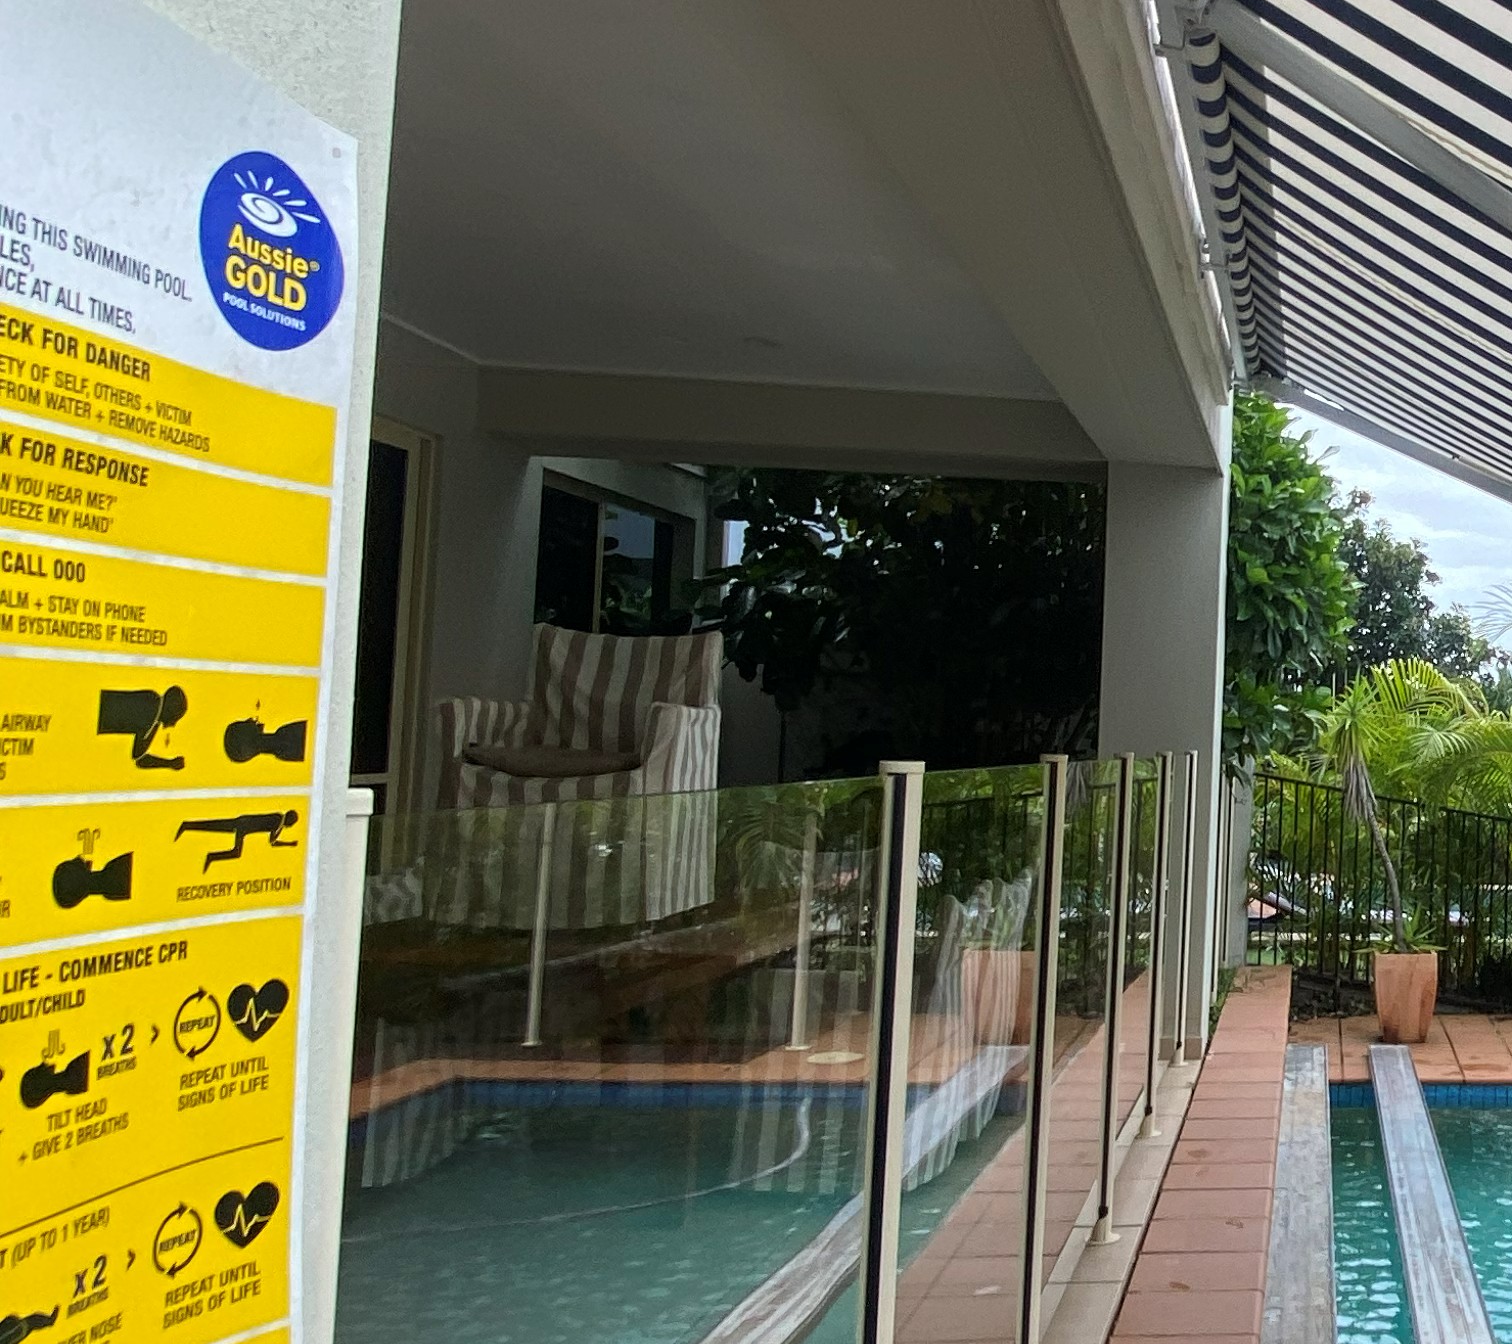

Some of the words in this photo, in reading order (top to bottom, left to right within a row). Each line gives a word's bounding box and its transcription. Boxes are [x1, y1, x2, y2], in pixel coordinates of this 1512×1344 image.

[33, 217, 67, 251] THIS
[73, 235, 150, 285] SWIMMING
[155, 269, 192, 302] POOL.
[31, 278, 52, 303] AT
[55, 287, 84, 315] ALL
[225, 255, 307, 312] GOLD
[223, 291, 248, 312] POOL
[249, 302, 306, 332] SOLUTIONS
[42, 327, 78, 359] FOR
[86, 342, 150, 382] DANGER
[31, 363, 50, 384] OF
[55, 370, 89, 399] SELF,
[94, 382, 142, 411] OTHERS
[155, 400, 192, 427] VICTIM
[44, 390, 92, 419] WATER
[108, 409, 157, 438] REMOVE
[158, 424, 211, 453] HAZARDS
[19, 437, 56, 467] FOR
[61, 447, 150, 487] RESPONSE
[15, 475, 44, 498] YOU
[46, 481, 82, 506] HEAR
[47, 504, 70, 527] MY
[1, 550, 47, 578] CALL
[48, 595, 80, 615] STAY
[83, 599, 101, 618] ON
[104, 602, 147, 623] PHONE
[18, 615, 103, 641] BYSTANDERS
[105, 624, 118, 641] IF
[121, 626, 168, 647] NEEDED
[176, 881, 234, 903] RECOVERY
[236, 876, 291, 896] POSITION
[3, 965, 40, 994] LIFE
[59, 946, 153, 983] COMMENCE
[158, 940, 188, 964] CPR
[119, 1022, 135, 1055] 2
[180, 1015, 215, 1034] REPEAT
[180, 1064, 227, 1091] REPEAT
[231, 1056, 269, 1078] UNTIL
[178, 1086, 215, 1112] SIGNS
[219, 1082, 237, 1100] OF
[240, 1074, 269, 1096] LIFE
[47, 1109, 72, 1132] TILT
[74, 1098, 107, 1124] HEAD
[33, 1134, 62, 1161] GIVE
[64, 1131, 74, 1151] 2
[76, 1112, 129, 1146] BREATHS
[40, 1228, 57, 1254] TO
[73, 1205, 110, 1239] YEAR)
[92, 1254, 107, 1290] 2
[165, 1274, 216, 1308] REPEAT
[219, 1260, 261, 1288] UNTIL
[163, 1299, 203, 1330] SIGNS
[207, 1290, 226, 1312] OF
[230, 1278, 261, 1305] LIFE
[89, 1311, 123, 1344] NOSE
